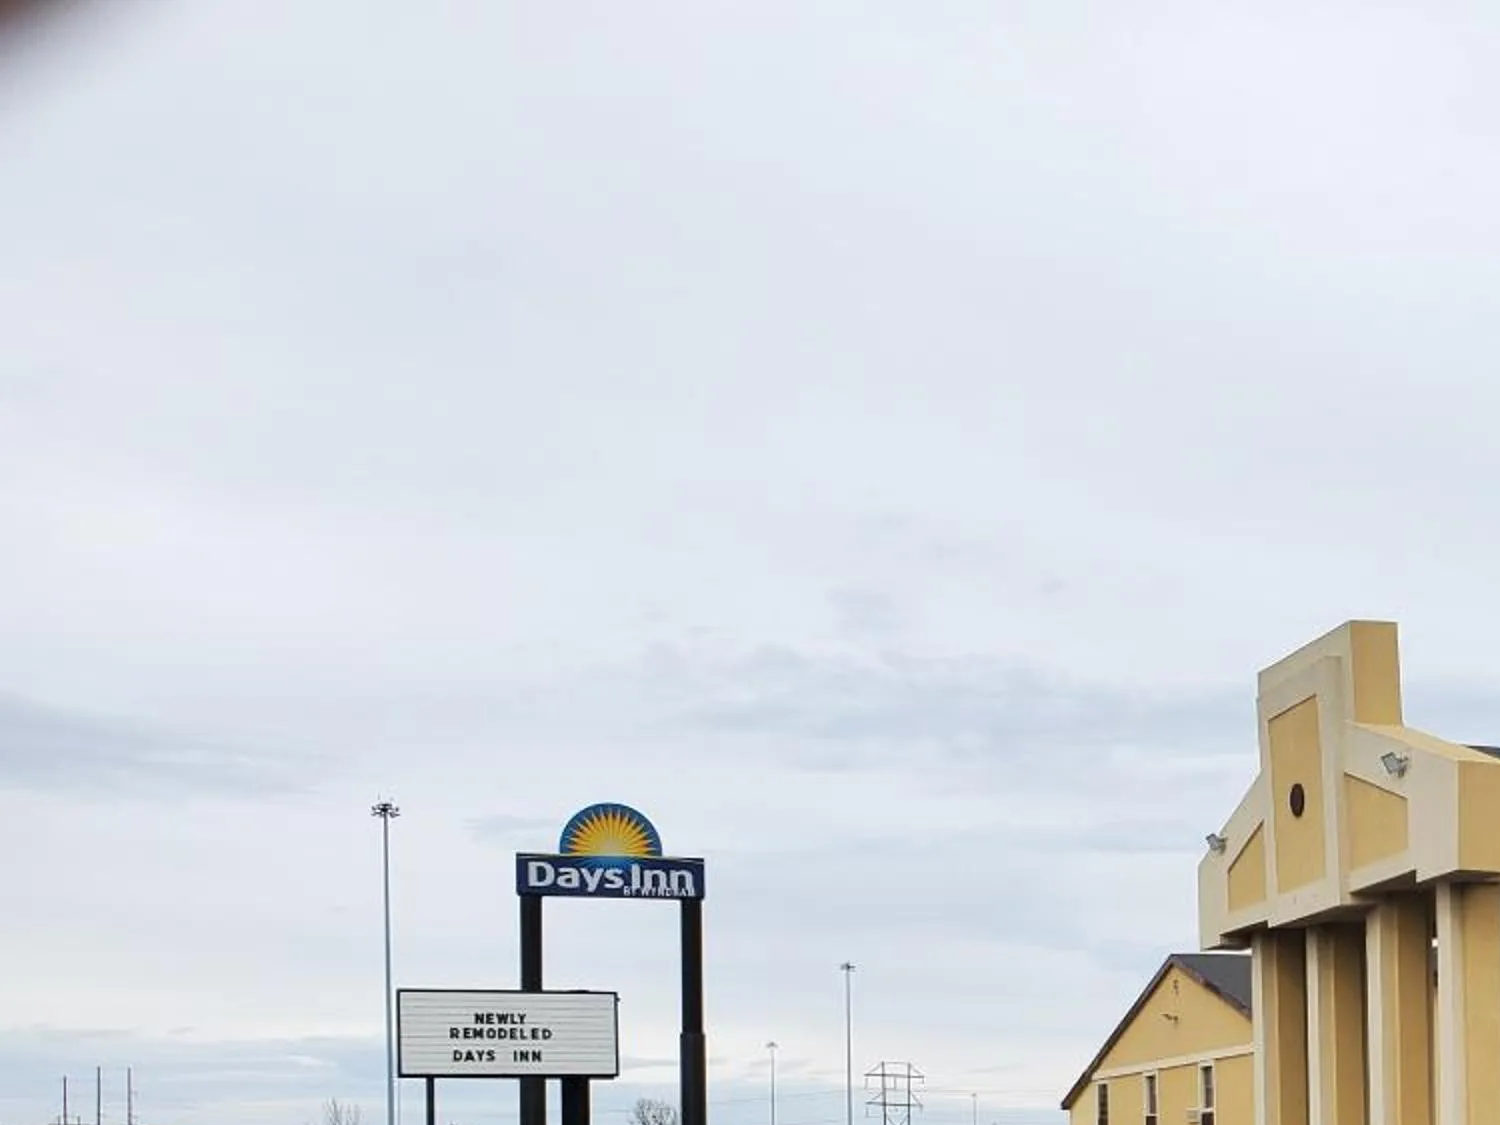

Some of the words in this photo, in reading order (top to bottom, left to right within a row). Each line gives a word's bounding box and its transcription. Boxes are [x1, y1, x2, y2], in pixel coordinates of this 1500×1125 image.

[527, 861, 625, 893] Days
[630, 863, 695, 892] Inn
[474, 1012, 527, 1025] NEWLY
[449, 1027, 553, 1040] REMODELED
[453, 1049, 496, 1062] DAYS
[512, 1049, 543, 1062] INN
